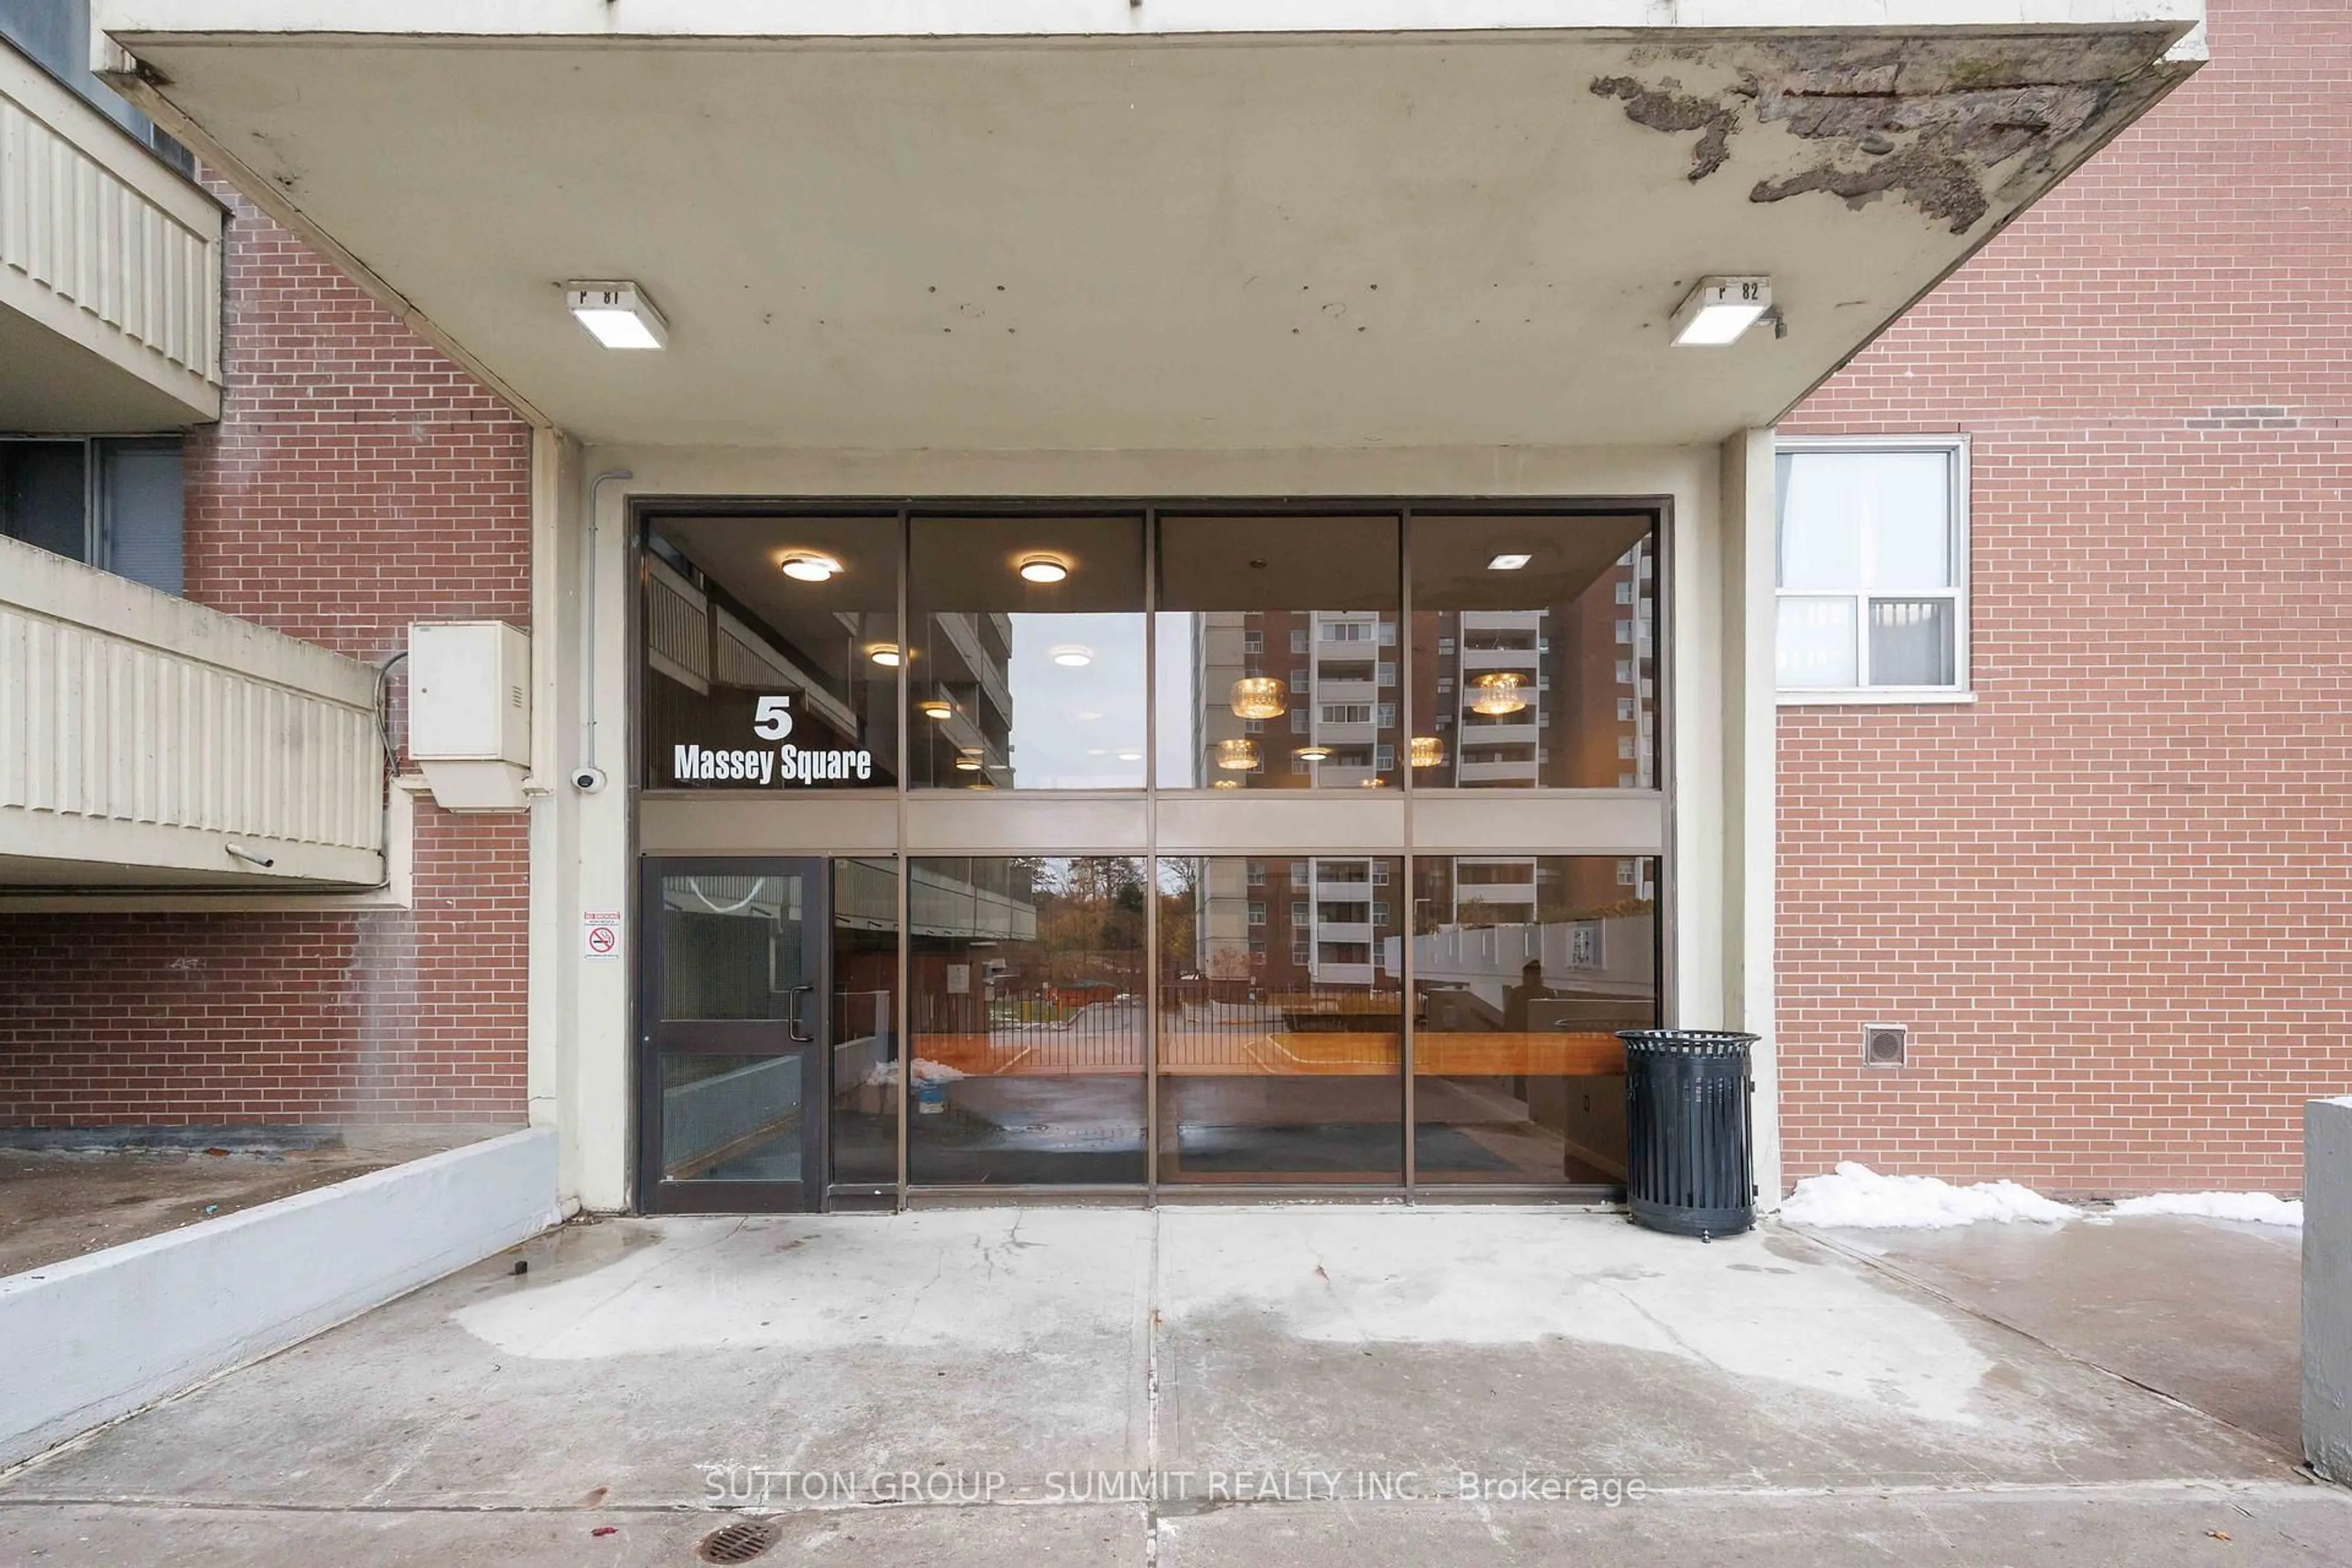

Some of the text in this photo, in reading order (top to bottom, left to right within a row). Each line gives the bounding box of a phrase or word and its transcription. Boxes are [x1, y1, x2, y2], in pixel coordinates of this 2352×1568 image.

[603, 291, 619, 305] 81
[1743, 282, 1758, 300] 82
[753, 695, 793, 741] 5
[674, 744, 872, 785] Massey Square
